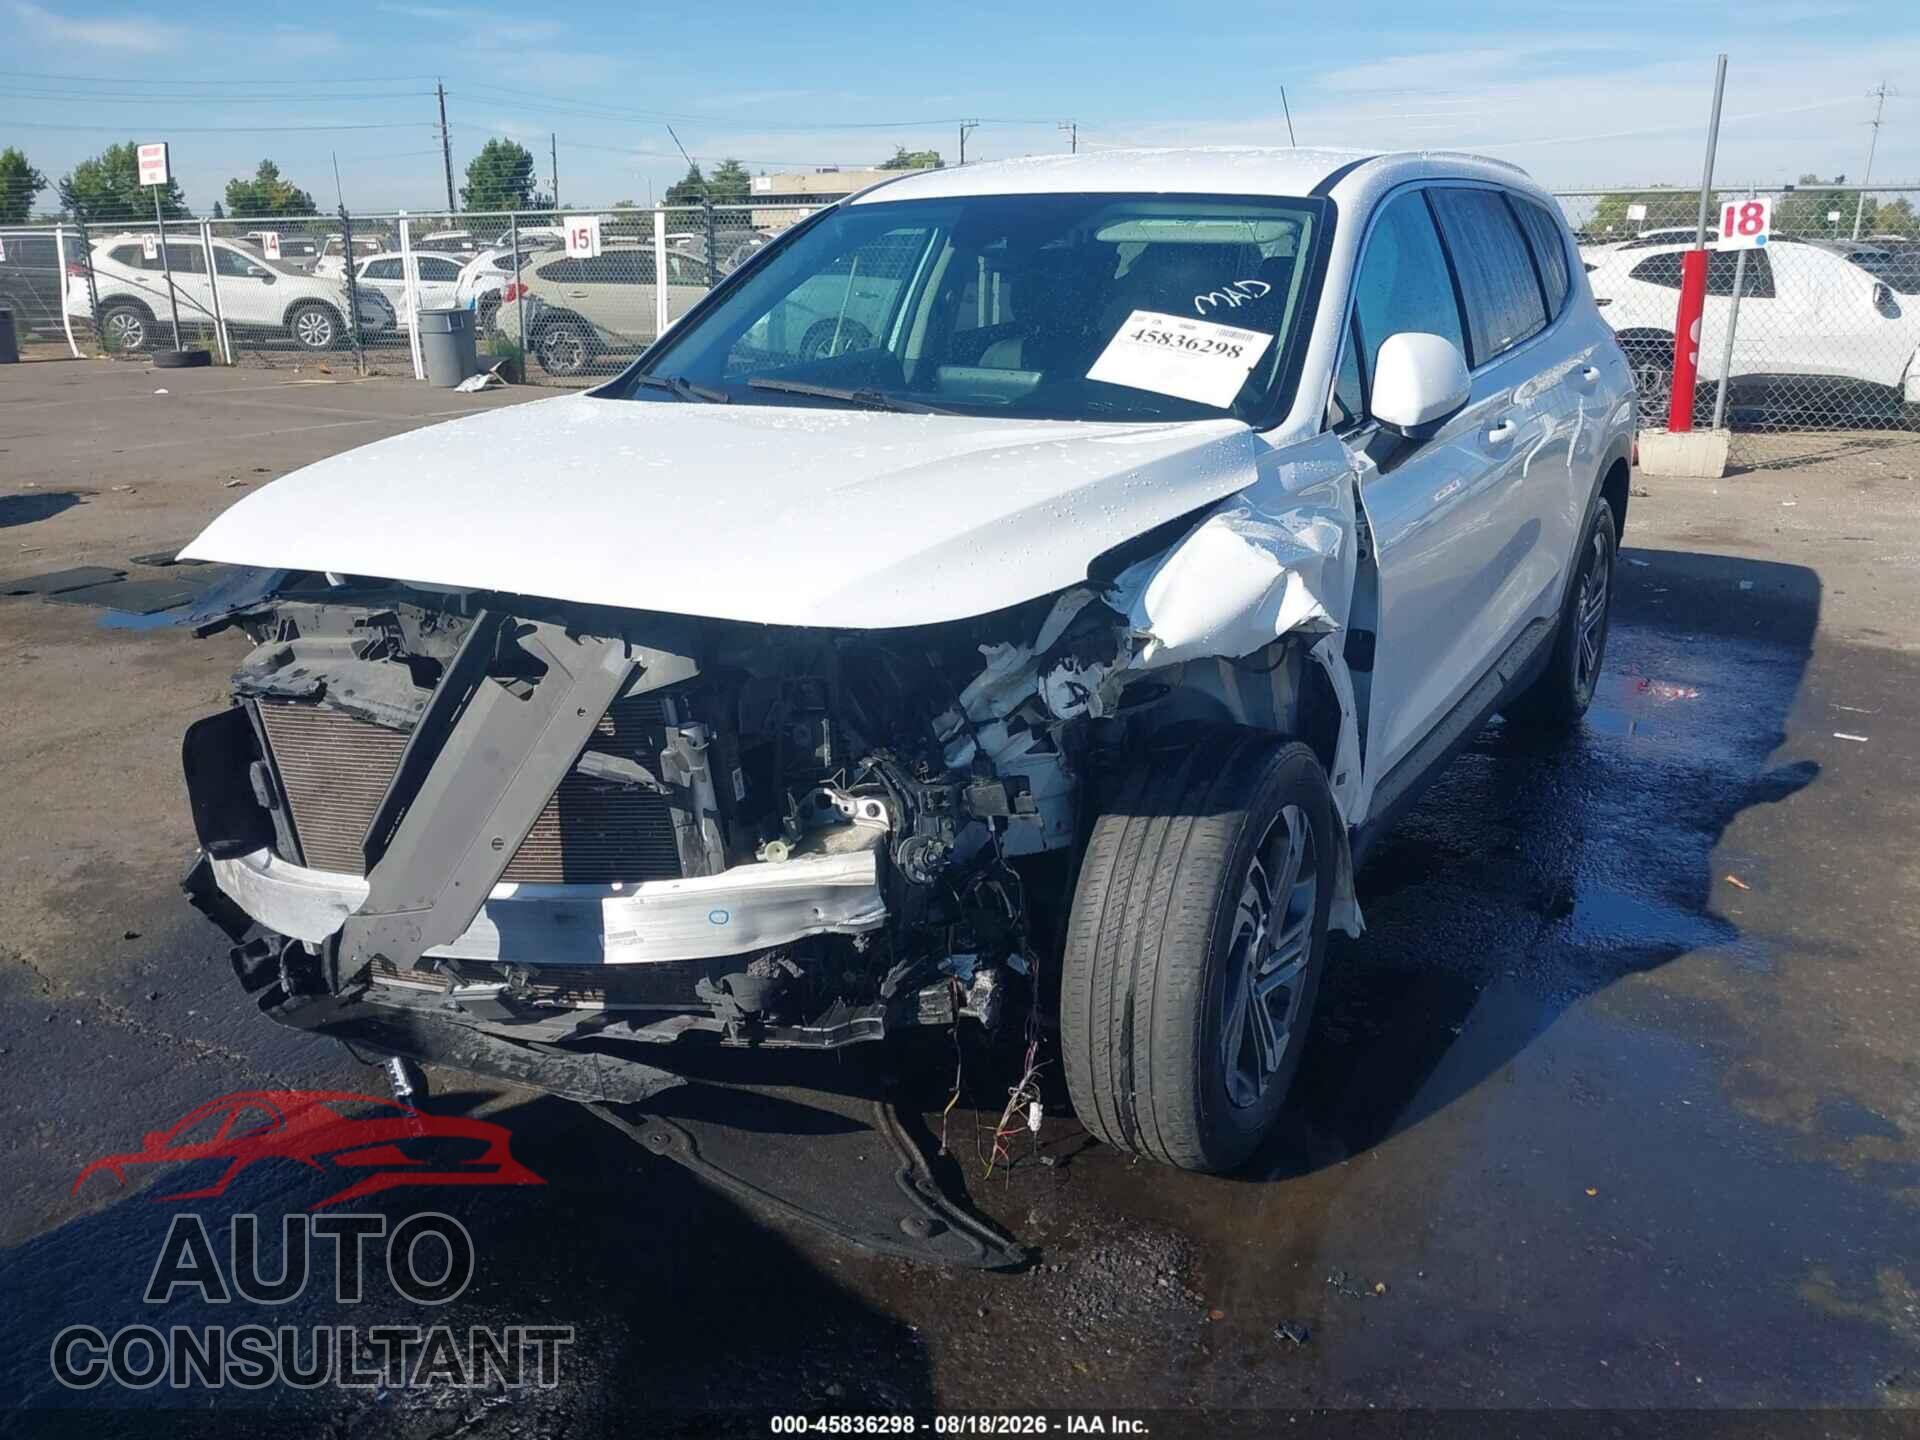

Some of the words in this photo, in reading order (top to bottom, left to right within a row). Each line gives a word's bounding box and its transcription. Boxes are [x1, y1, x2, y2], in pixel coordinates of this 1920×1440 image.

[1724, 202, 1764, 238] 18
[264, 234, 278, 251] 14
[572, 229, 590, 249] 15
[1194, 279, 1272, 315] MAD
[1130, 328, 1244, 359] 45836298
